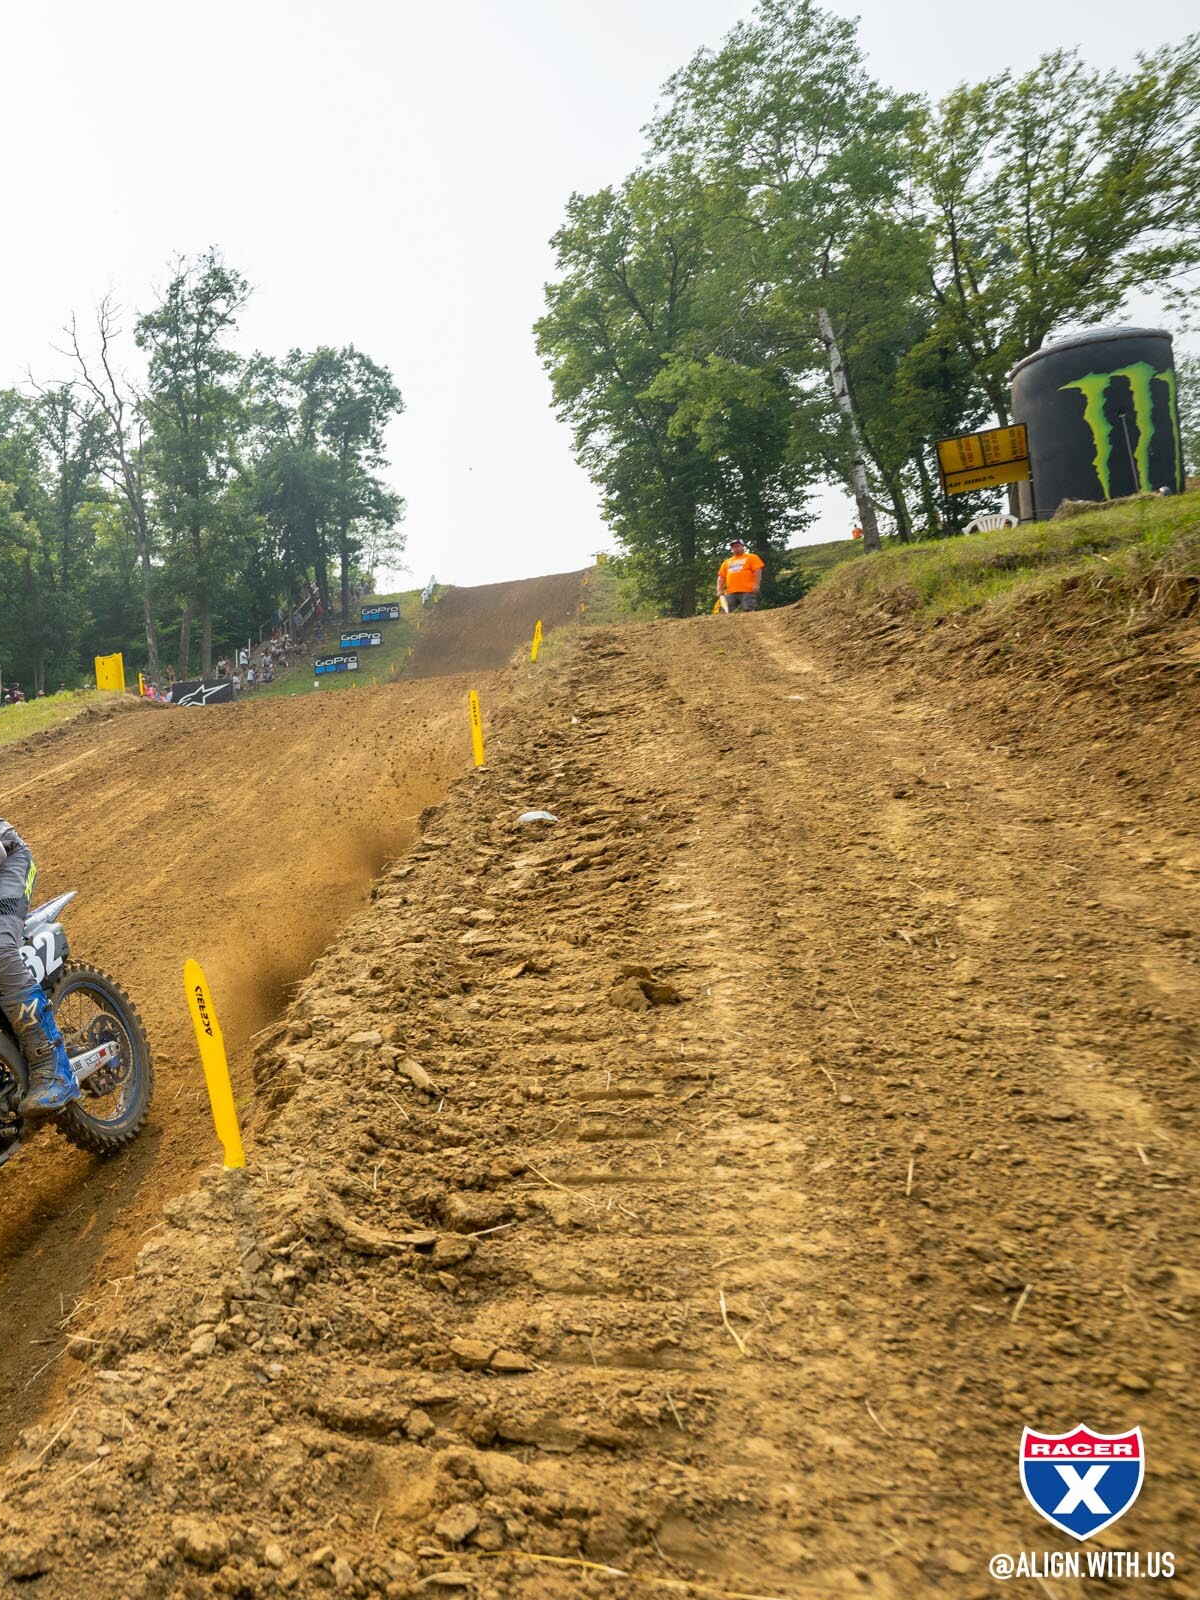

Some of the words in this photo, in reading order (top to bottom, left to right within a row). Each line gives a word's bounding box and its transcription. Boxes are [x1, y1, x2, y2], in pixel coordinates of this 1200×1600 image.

[361, 606, 399, 615] GoPro
[340, 632, 381, 641] GoPro
[315, 656, 358, 667] GoPro
[19, 931, 64, 984] 32
[195, 985, 213, 1037] ACERBIS
